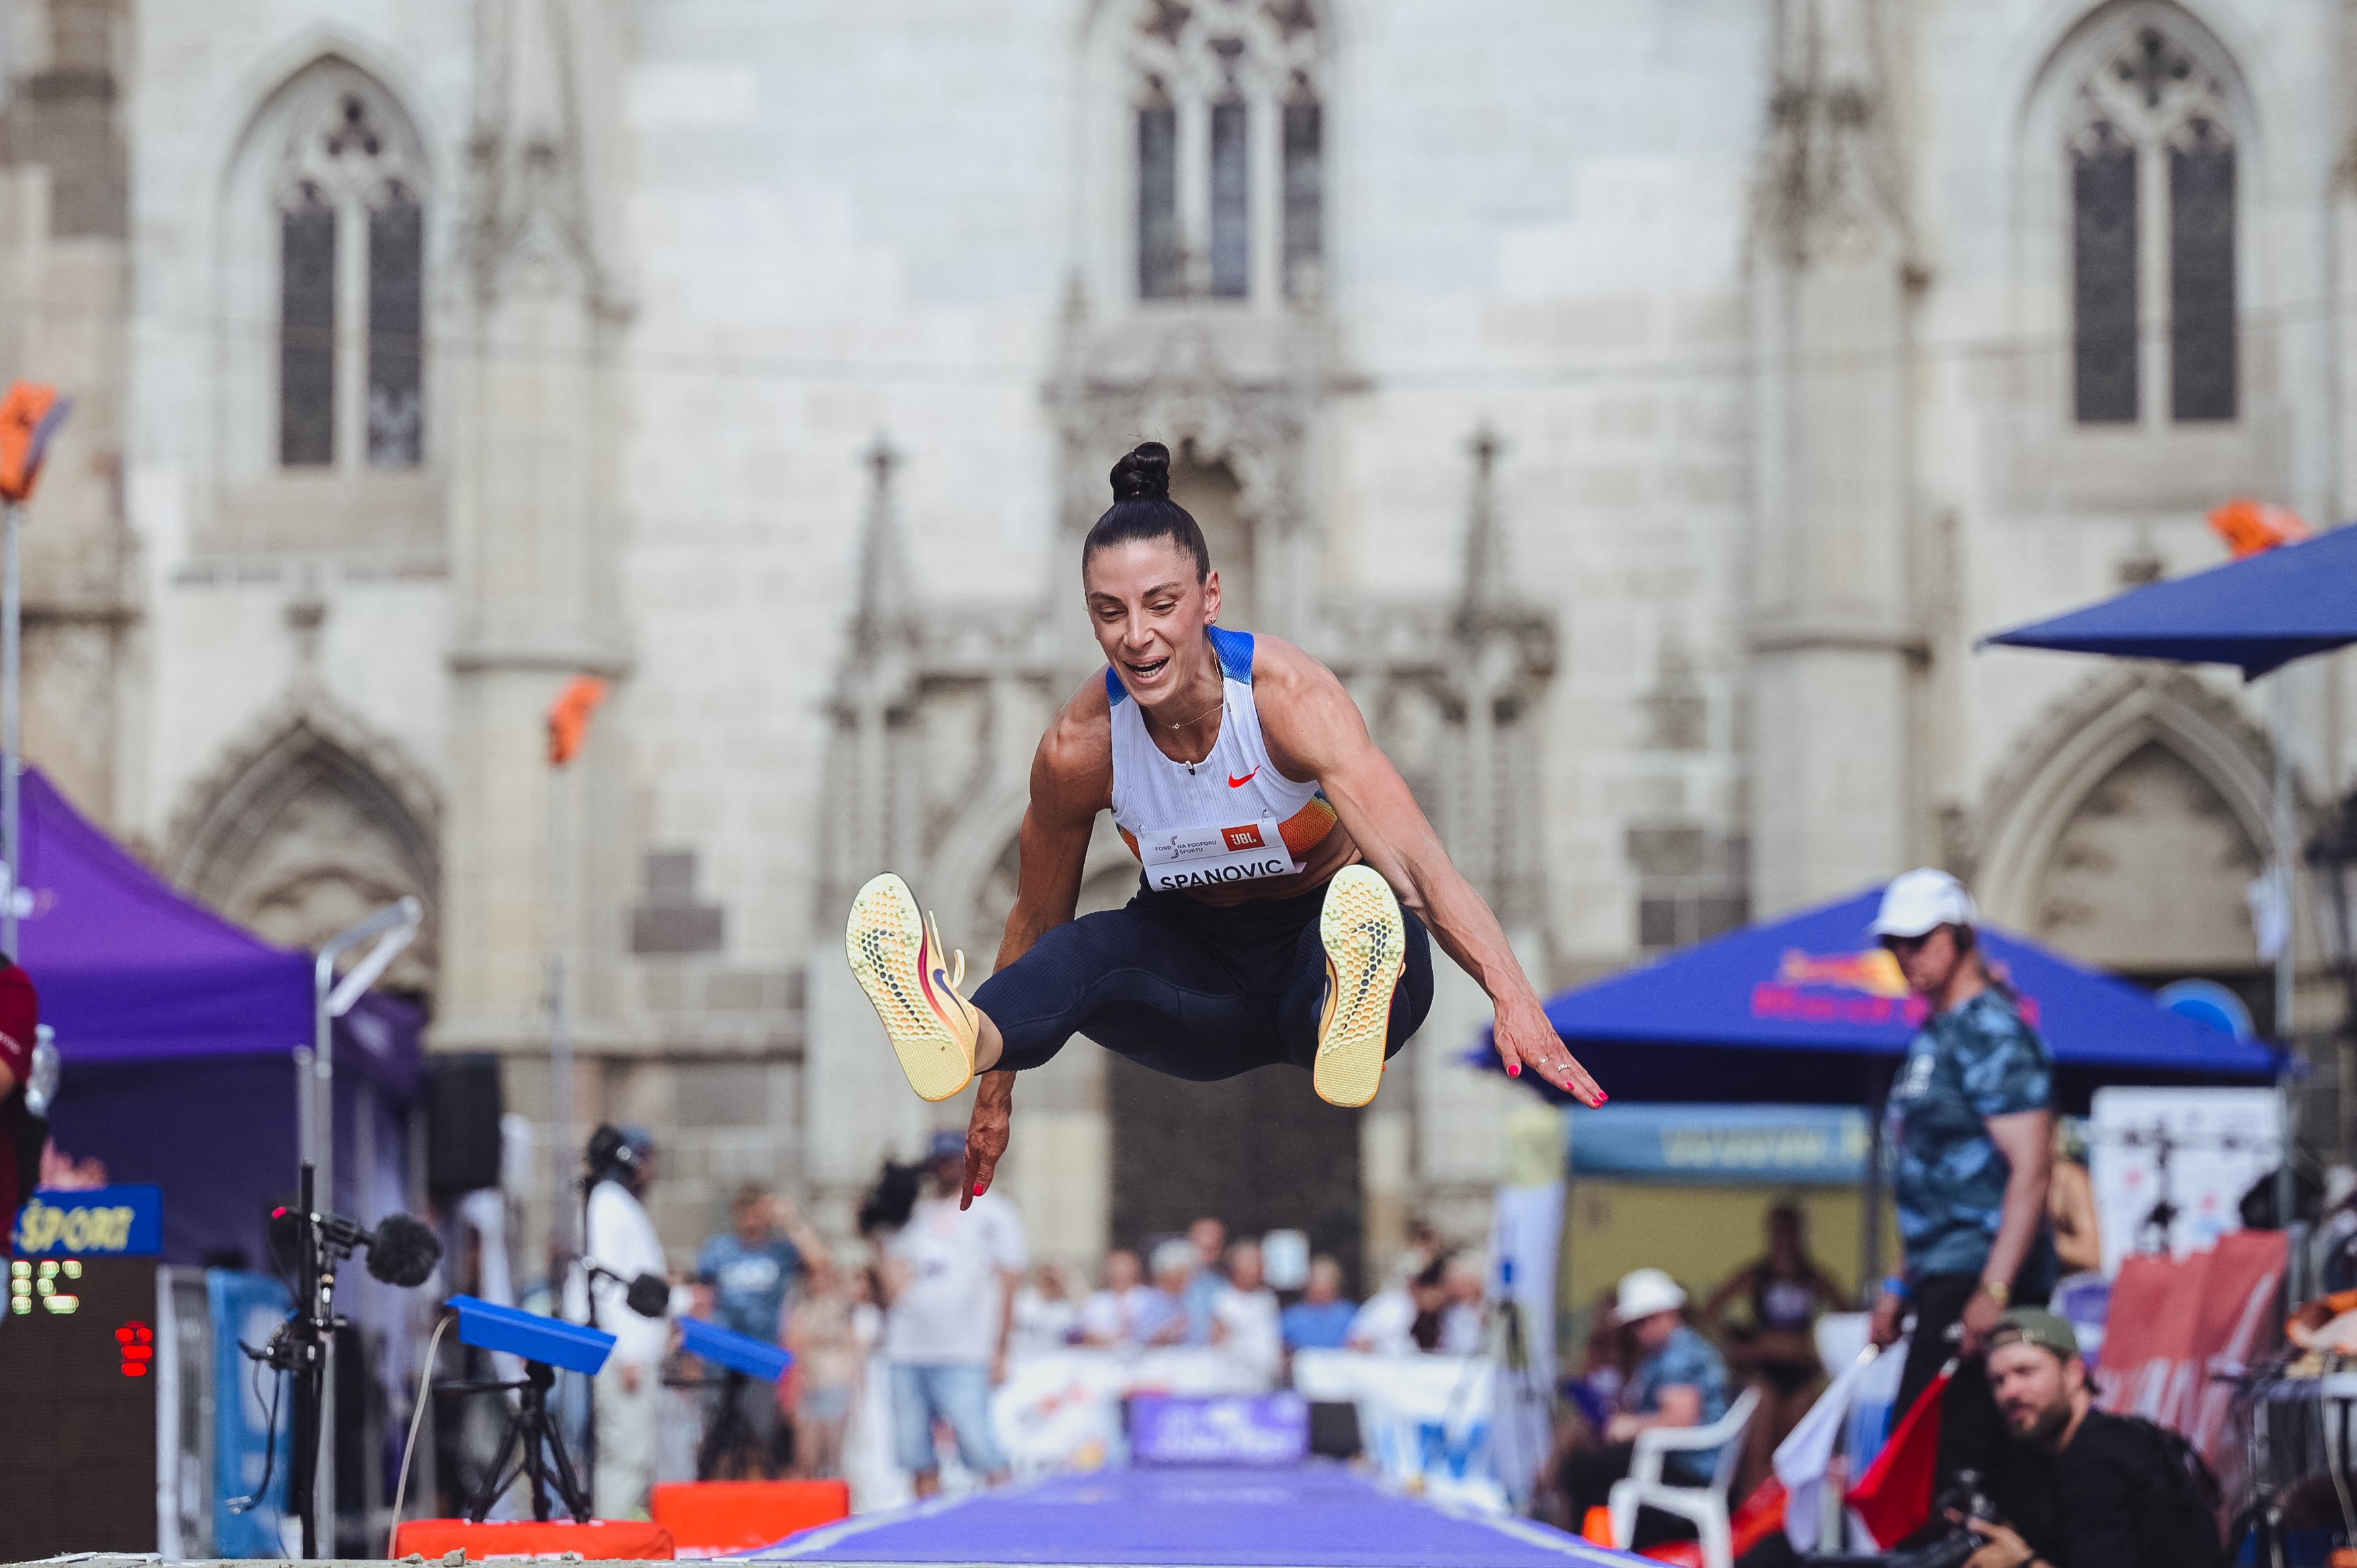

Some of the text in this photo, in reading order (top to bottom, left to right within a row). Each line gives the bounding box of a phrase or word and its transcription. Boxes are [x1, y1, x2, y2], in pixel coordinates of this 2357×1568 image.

[1188, 840, 1217, 848] PODPORU
[1230, 832, 1257, 845] JBL
[1160, 859, 1284, 890] SPANOVIC
